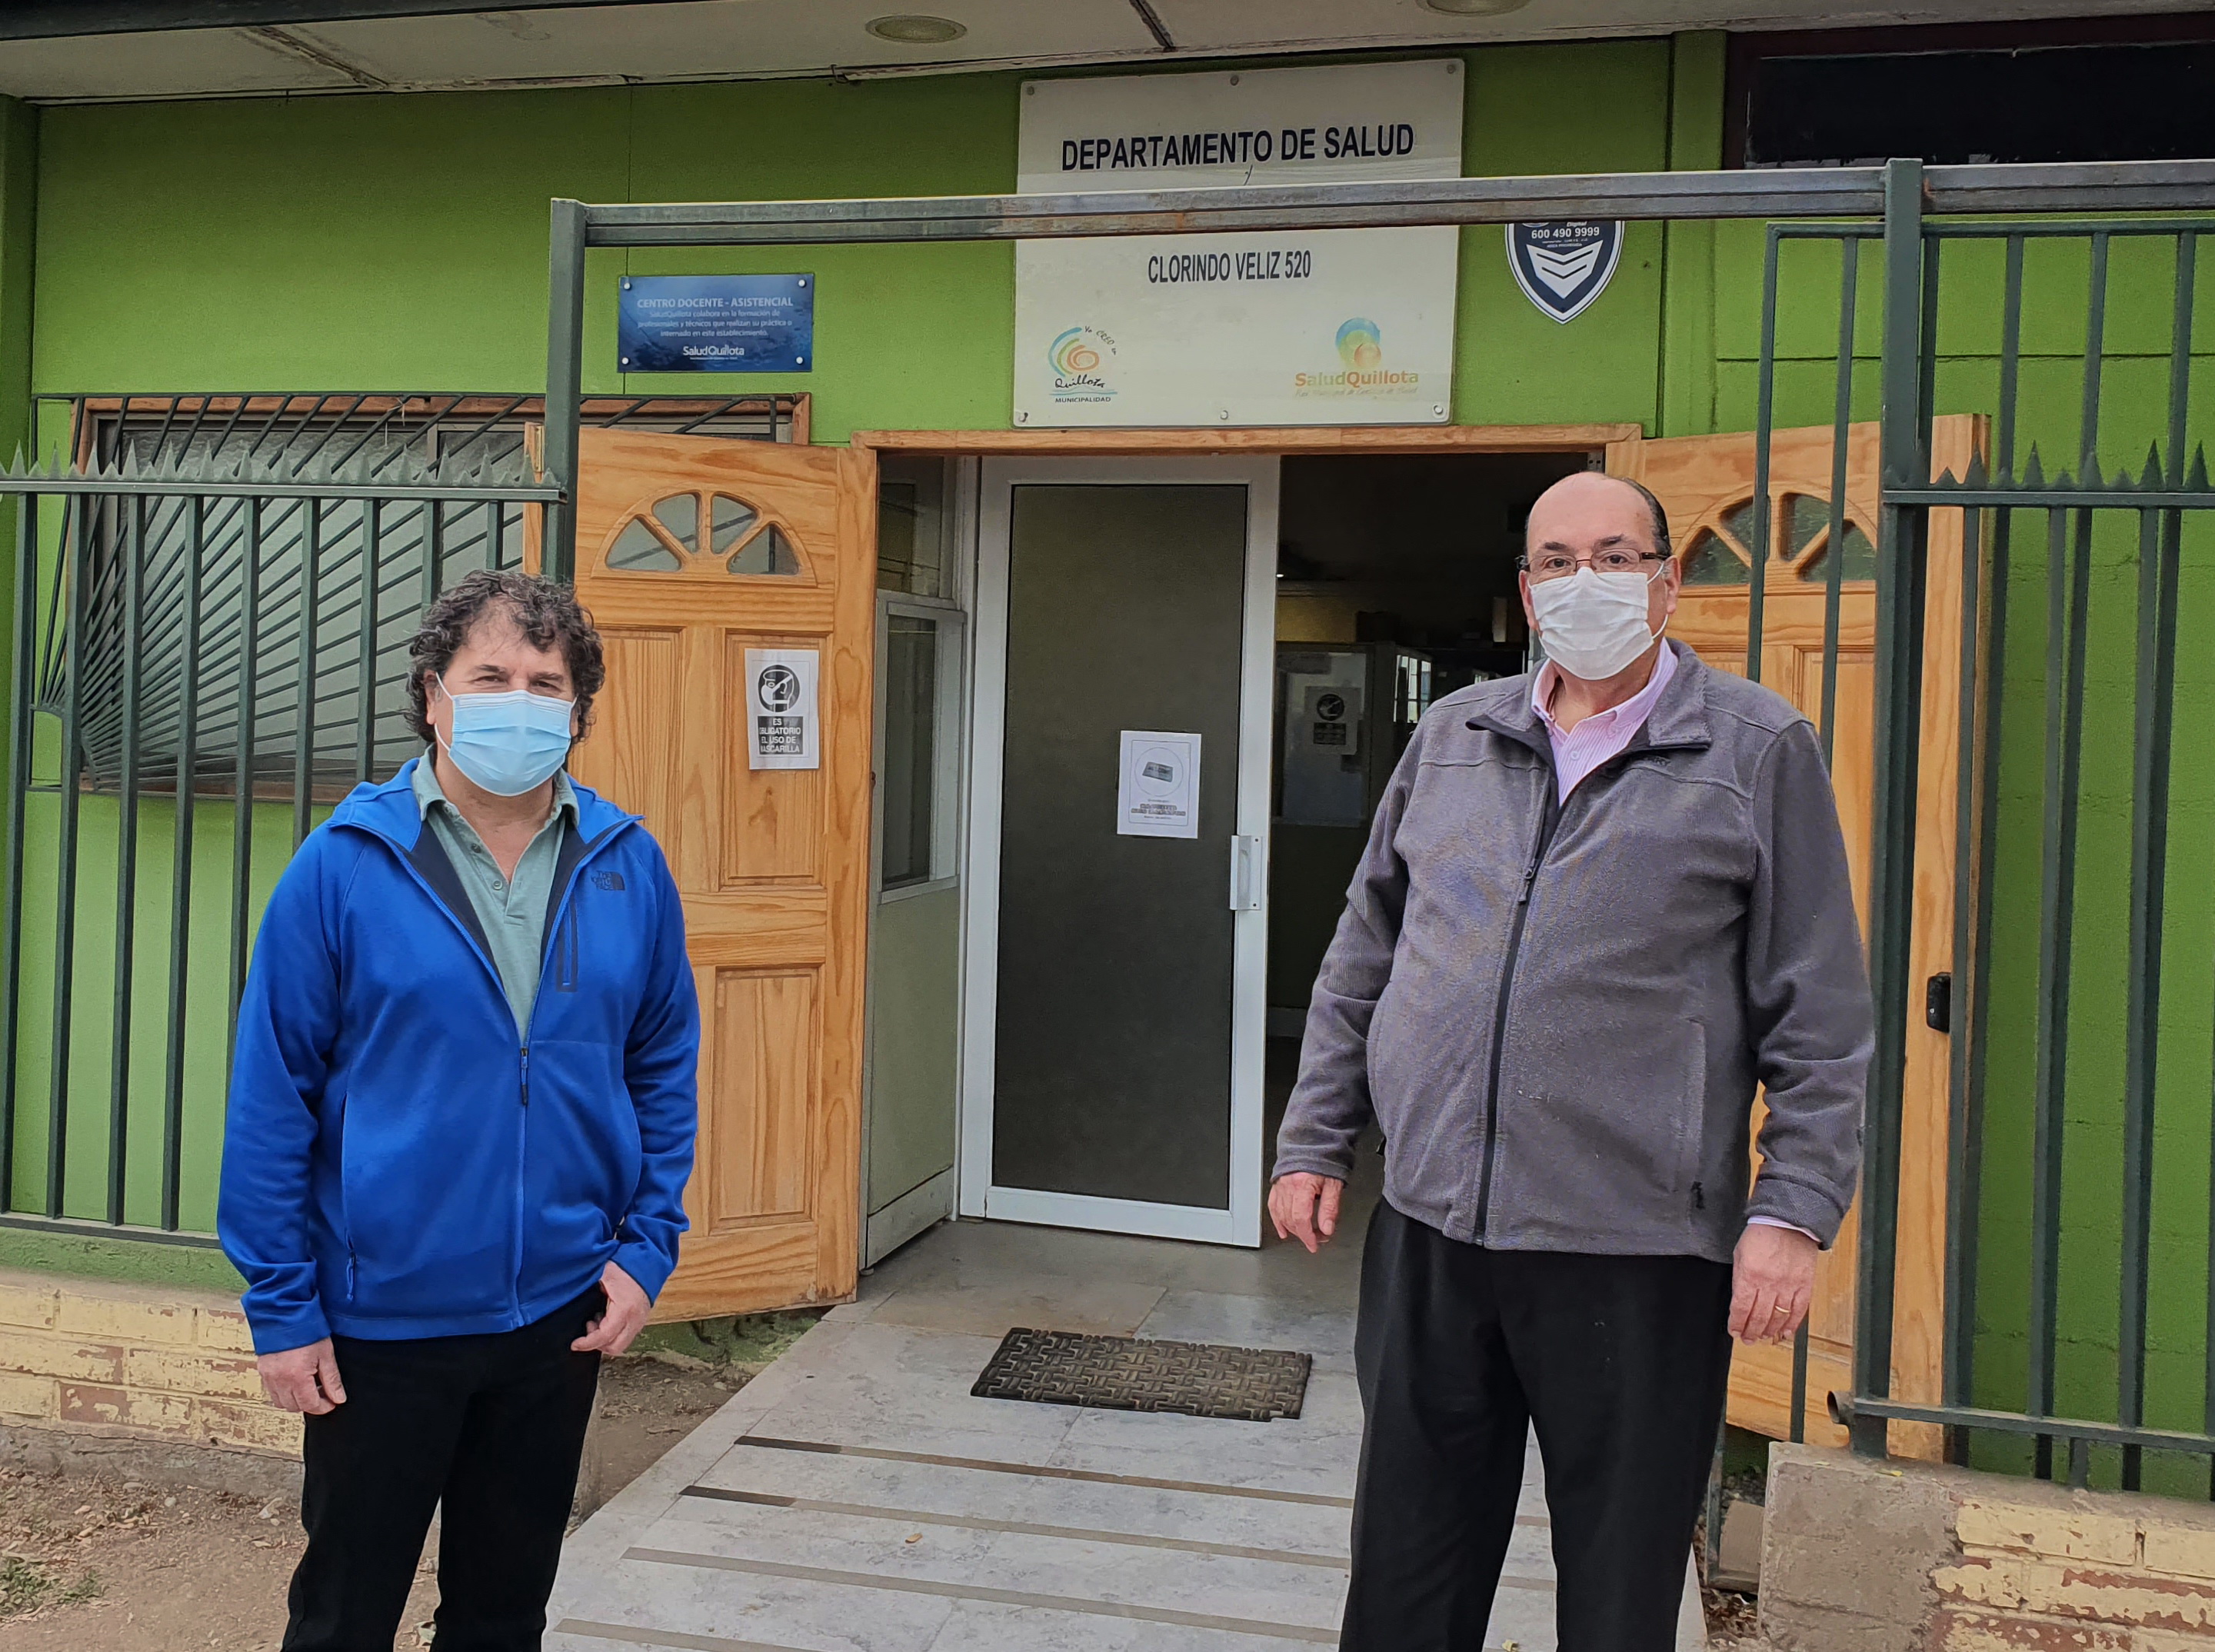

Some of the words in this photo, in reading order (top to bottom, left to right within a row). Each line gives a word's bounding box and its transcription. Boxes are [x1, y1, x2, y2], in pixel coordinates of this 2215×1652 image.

[1062, 130, 1272, 171] DEPARTAMENTO
[1281, 128, 1315, 160] DE
[1324, 124, 1414, 158] SALUD
[1531, 229, 1550, 239] 600
[1553, 228, 1571, 238] 490
[1574, 226, 1600, 237] 9999
[1148, 253, 1231, 283] CLORINDO
[1235, 251, 1281, 280] VELIZ
[1285, 250, 1311, 278] 520
[637, 298, 676, 308] CENTRO
[678, 298, 723, 308] DOCENTE
[731, 297, 793, 307] ASISTENCIAL
[682, 344, 744, 355] SaludQuillota
[1054, 374, 1106, 388] Quillota
[1294, 370, 1419, 388] SaludQuillota
[772, 718, 782, 726] ES
[769, 736, 784, 744] USO
